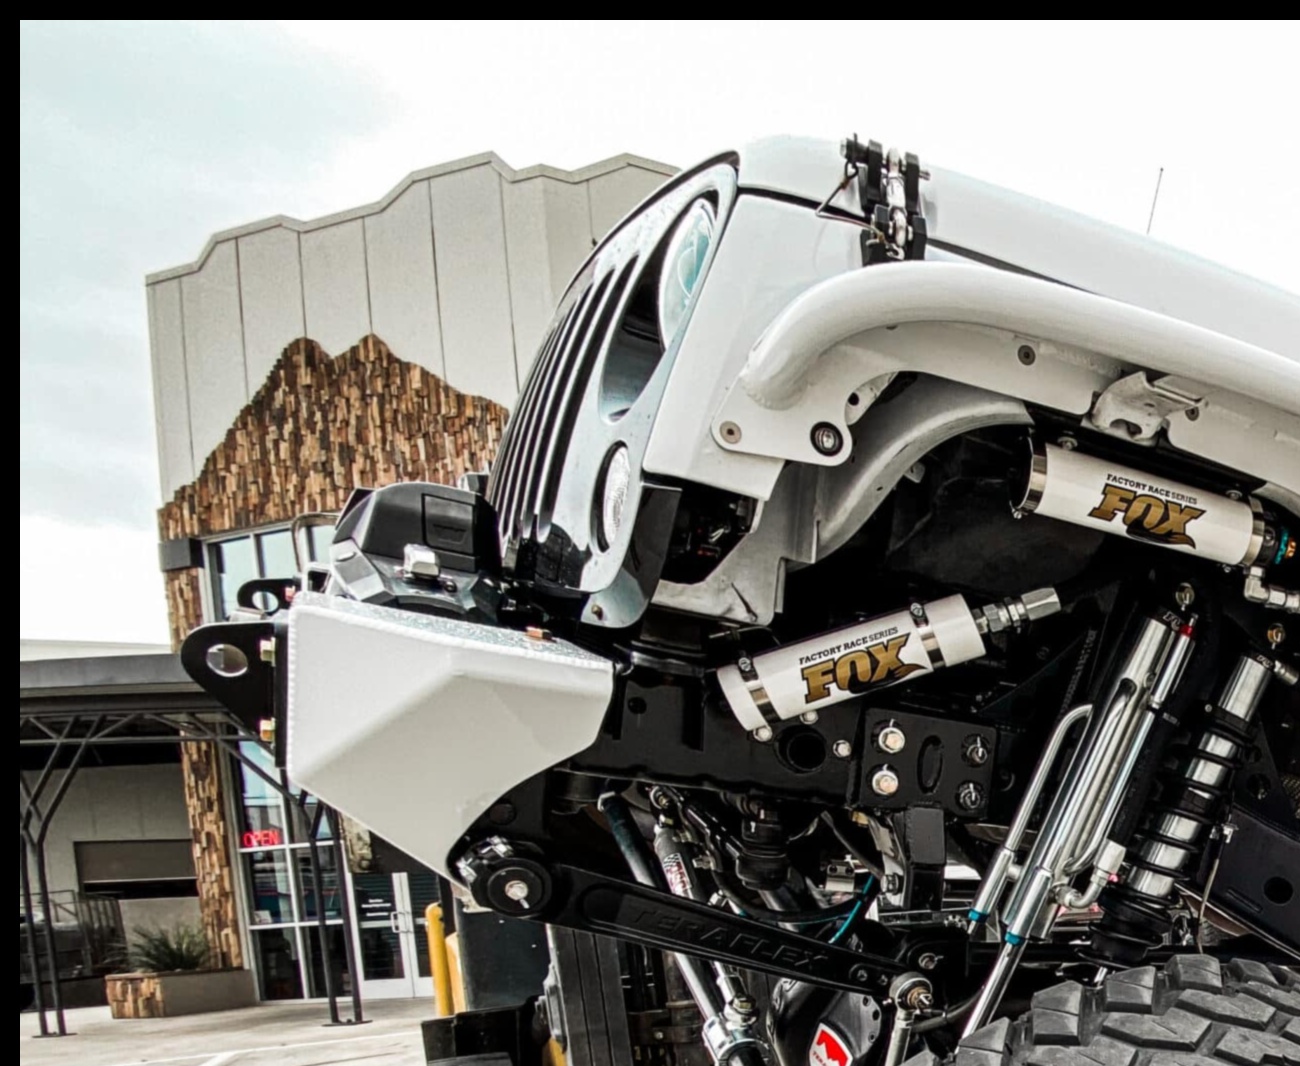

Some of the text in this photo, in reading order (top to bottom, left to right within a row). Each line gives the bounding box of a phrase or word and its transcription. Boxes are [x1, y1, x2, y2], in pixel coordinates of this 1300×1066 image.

[1106, 473, 1198, 505] FACTORY RACE SERIES
[1087, 482, 1207, 548] FOX
[799, 626, 899, 665] FACTORY RACE SERIES
[800, 632, 922, 704] FOX
[243, 829, 280, 847] OPEN
[634, 908, 830, 968] TERAFLEX
